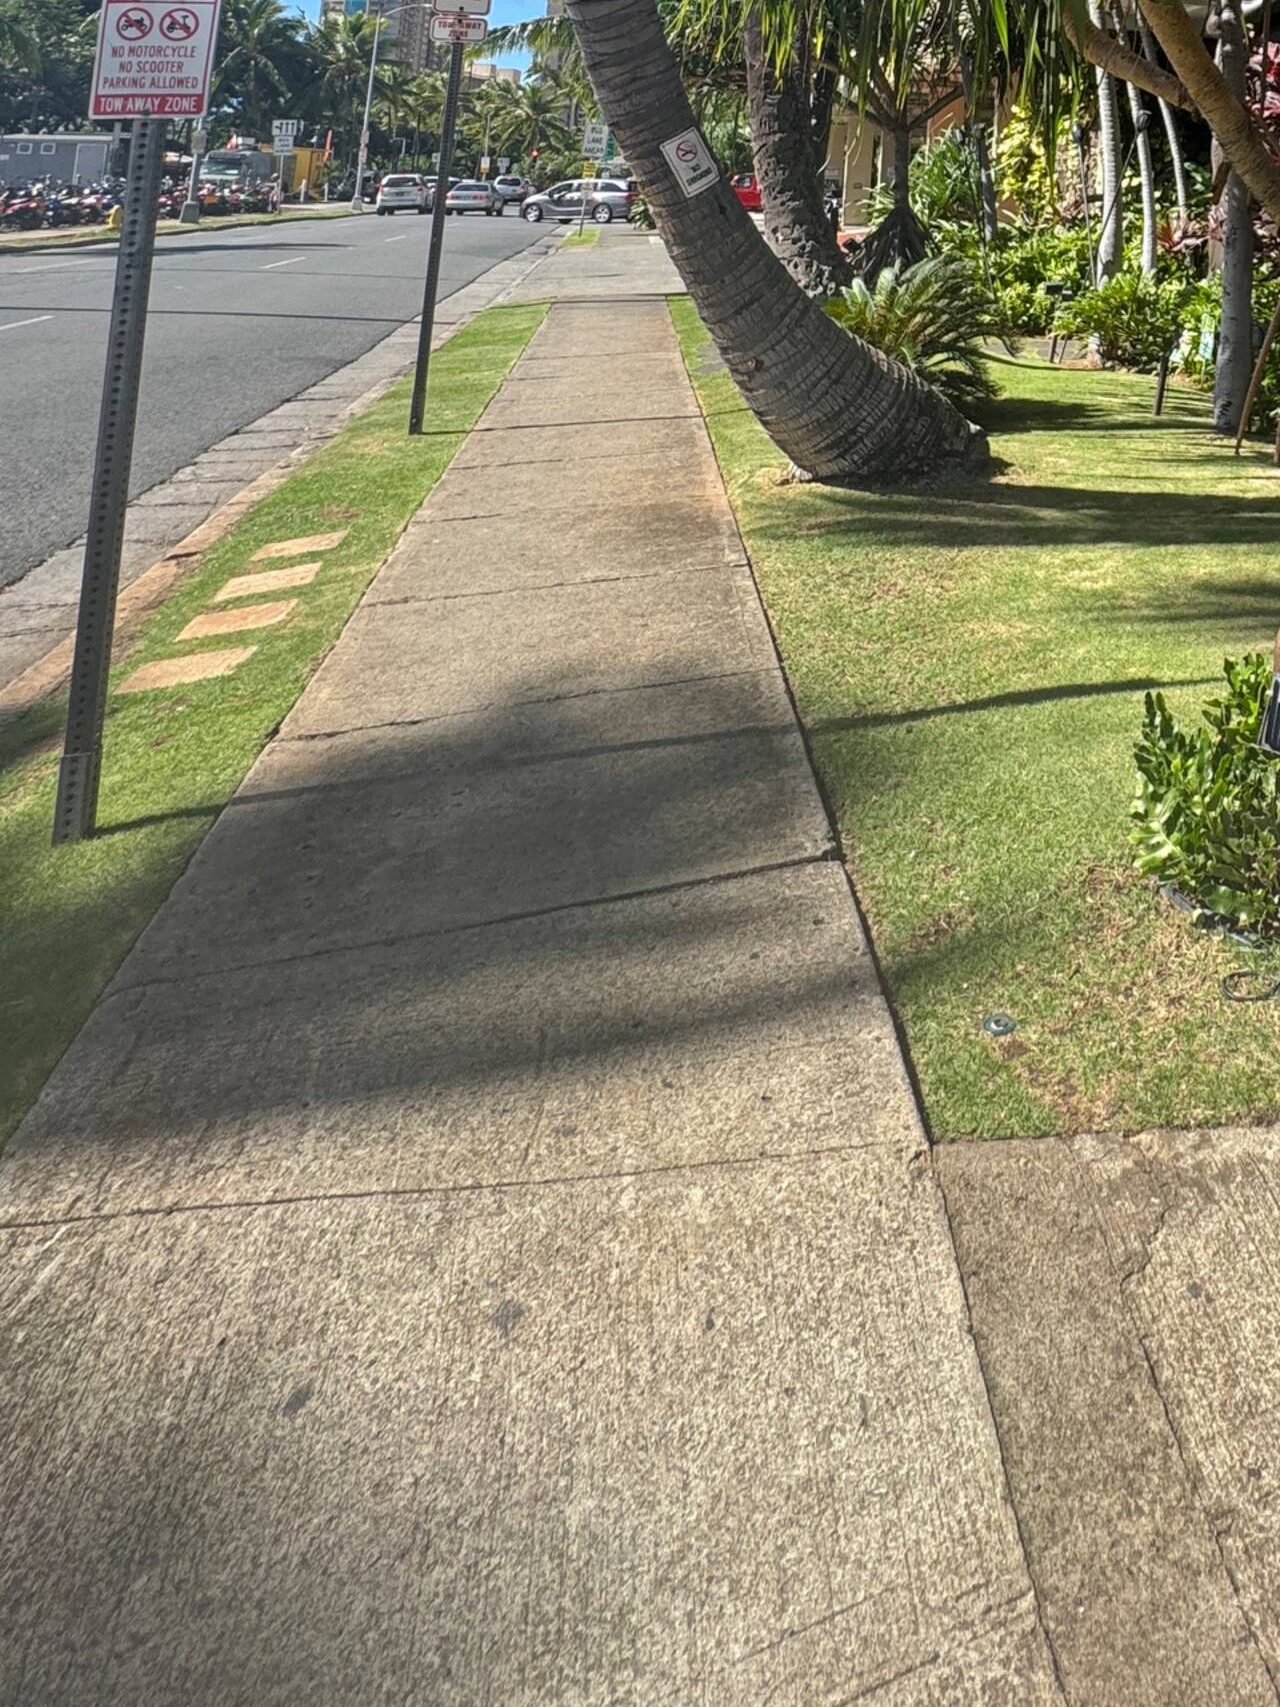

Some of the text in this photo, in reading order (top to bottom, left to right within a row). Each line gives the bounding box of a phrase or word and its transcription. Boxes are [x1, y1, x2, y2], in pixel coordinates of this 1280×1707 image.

[111, 45, 197, 59] NO MOTORCYCLE
[118, 61, 184, 73] NO SCOOTER
[102, 76, 198, 89] PARKING ALLOWED
[100, 96, 199, 113] TOW AWAY ZONE
